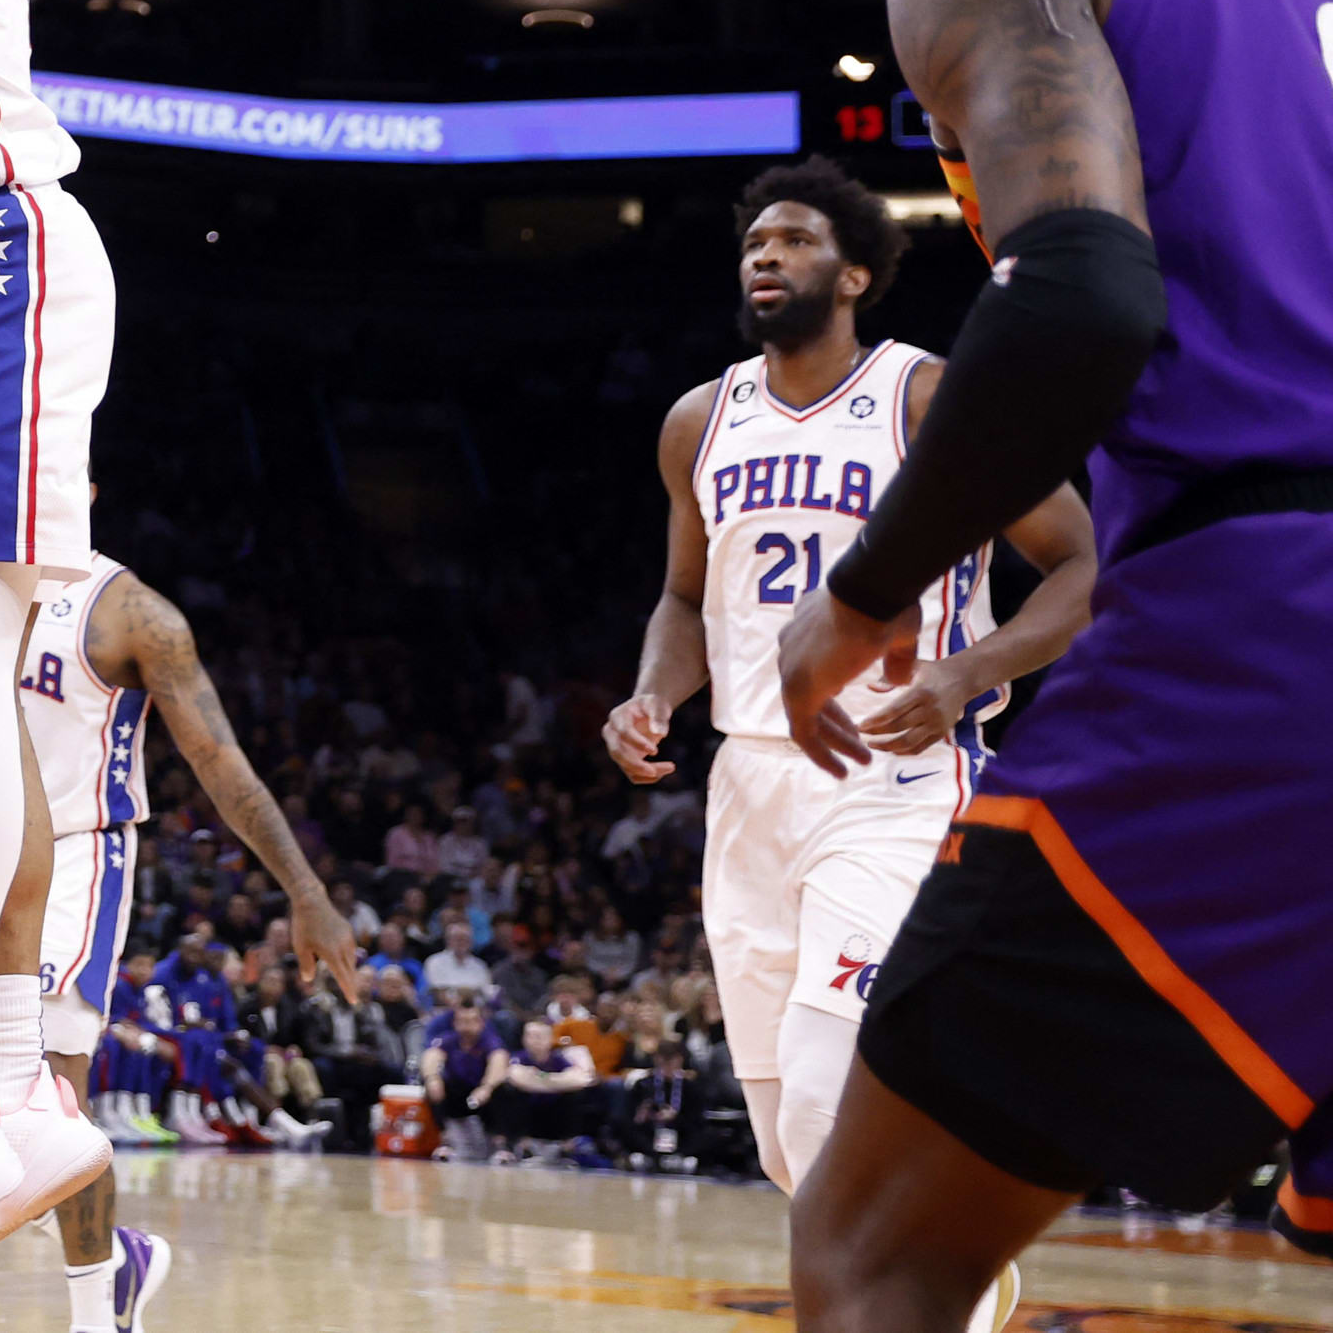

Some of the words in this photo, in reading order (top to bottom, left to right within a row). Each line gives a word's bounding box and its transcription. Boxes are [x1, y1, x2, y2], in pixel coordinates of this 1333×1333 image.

[836, 105, 883, 142] 13
[712, 454, 875, 525] PHILA
[755, 532, 822, 604] 21
